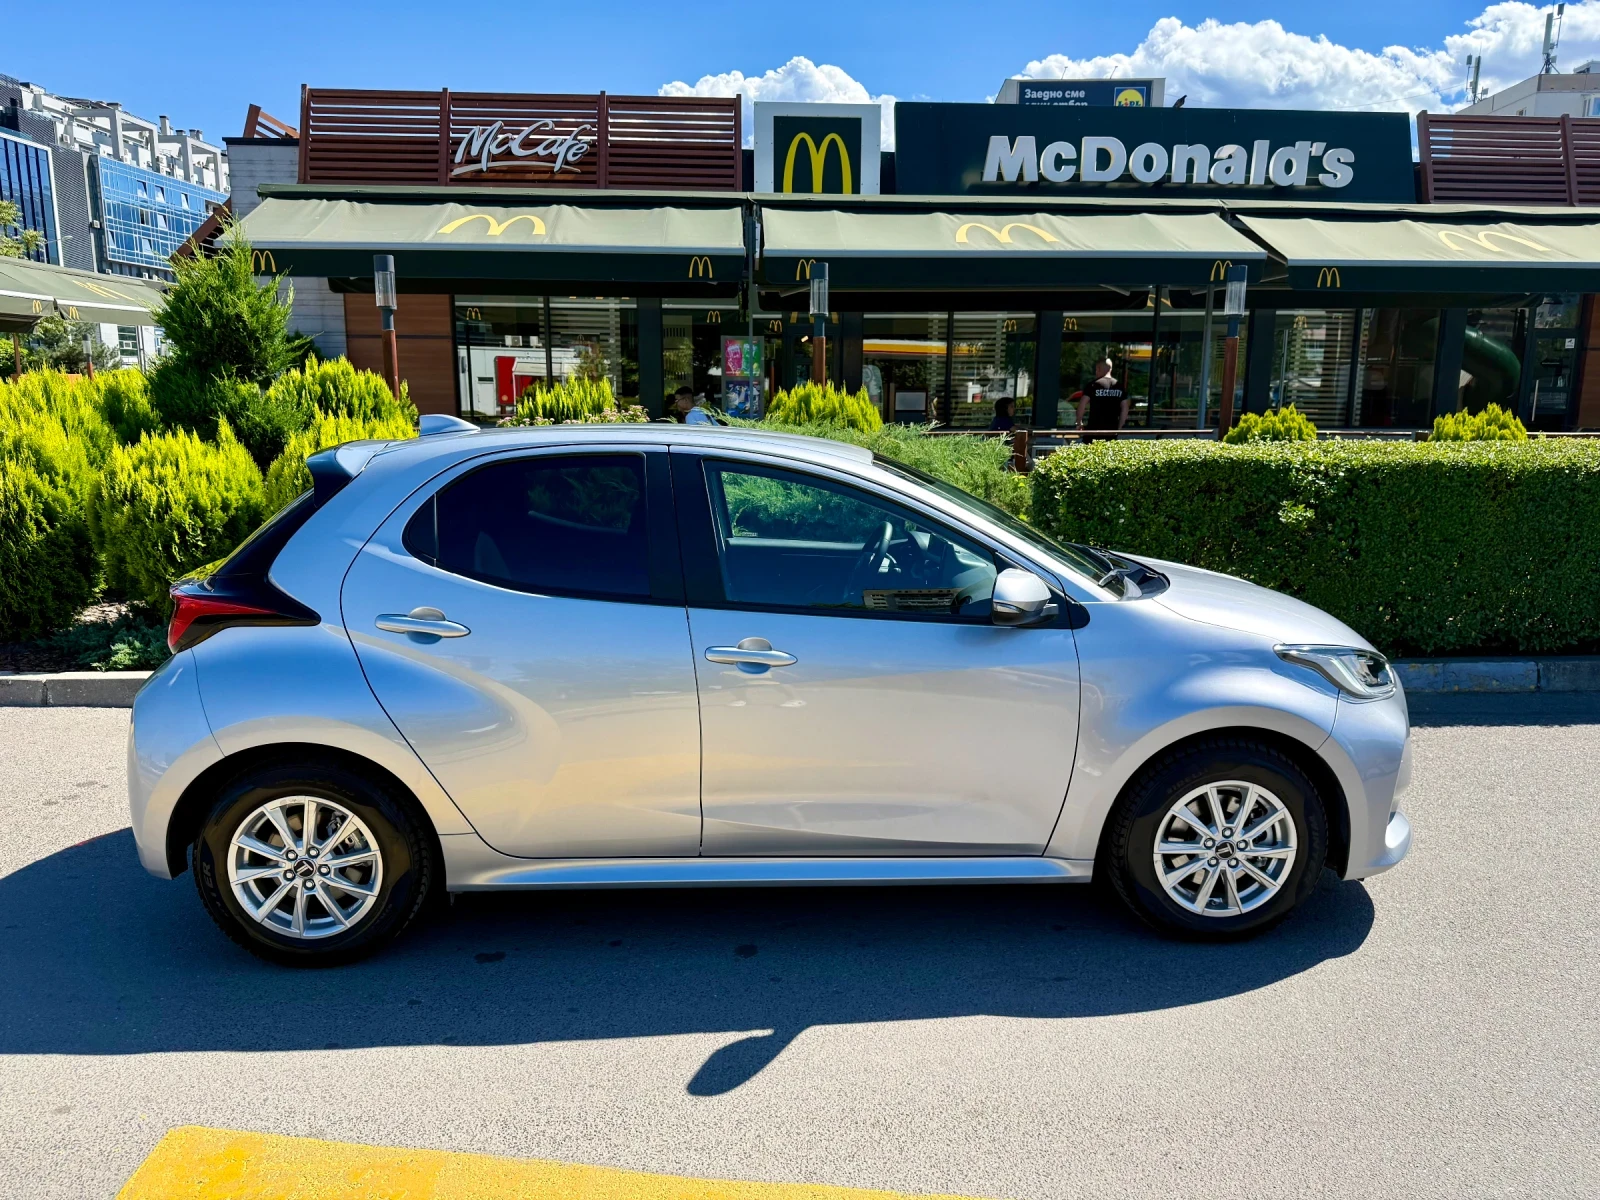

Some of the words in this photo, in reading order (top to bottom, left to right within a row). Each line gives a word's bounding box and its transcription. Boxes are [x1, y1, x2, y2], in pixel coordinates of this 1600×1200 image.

[1024, 88, 1063, 100] Заедно
[1065, 89, 1086, 98] сме
[454, 120, 592, 174] McCafé
[981, 135, 1355, 188] McDonald's
[1095, 389, 1122, 398] SECURITY
